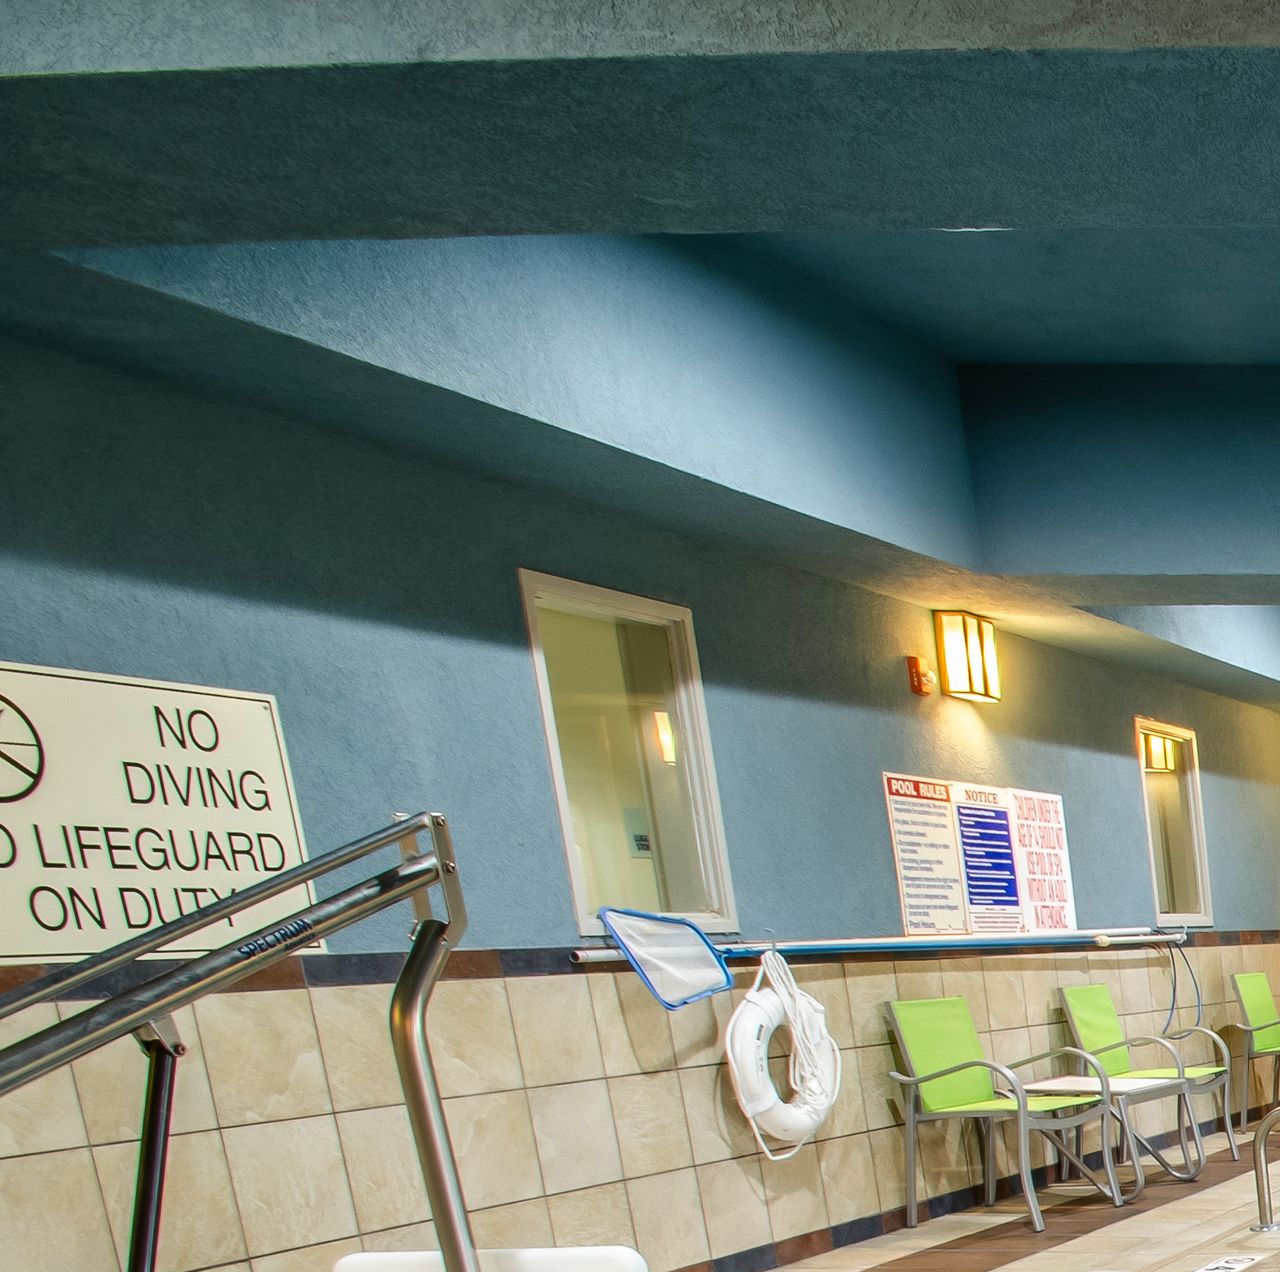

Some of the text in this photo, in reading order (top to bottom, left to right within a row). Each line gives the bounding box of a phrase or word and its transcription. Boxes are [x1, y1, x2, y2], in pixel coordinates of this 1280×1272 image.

[154, 705, 219, 752] NO
[122, 761, 272, 811] DIVING
[891, 779, 947, 800] POOL RULES
[965, 789, 998, 804] NOTICE
[33, 824, 285, 871] LIFEGUARD
[30, 886, 237, 931] ON DUTY
[238, 918, 313, 958] SPECTRUM
